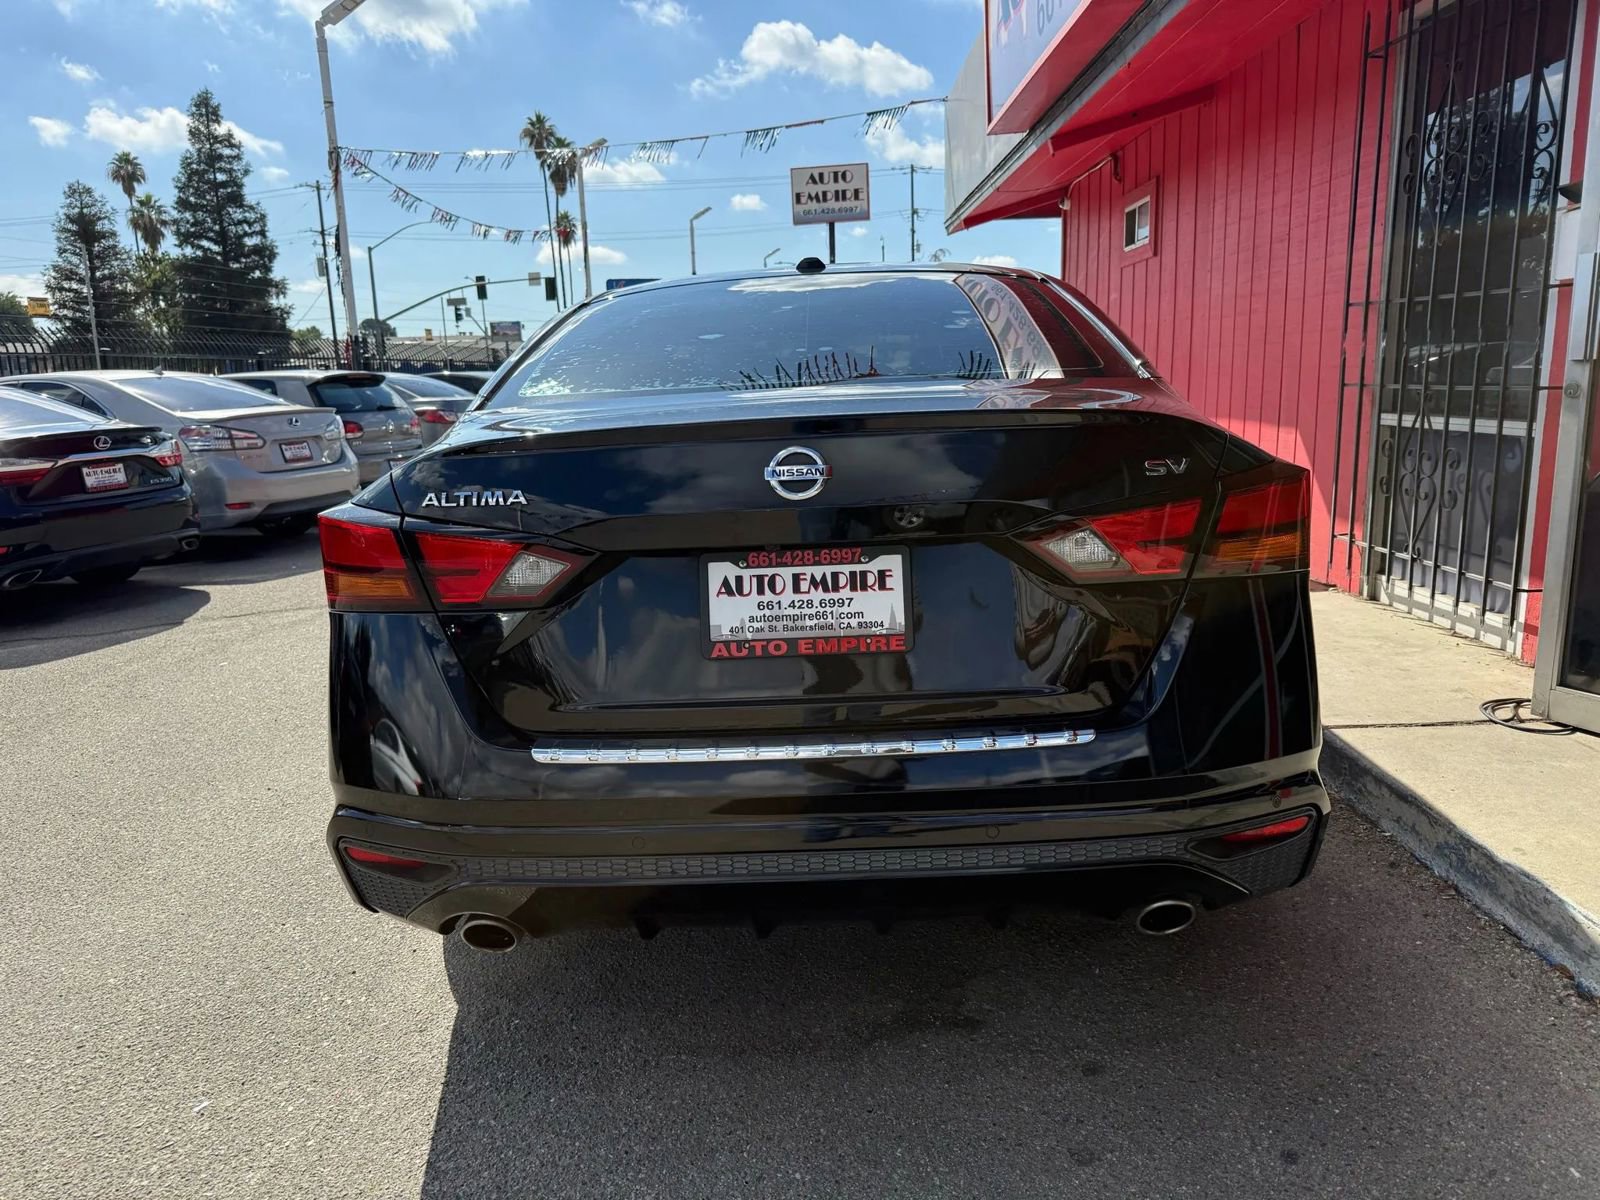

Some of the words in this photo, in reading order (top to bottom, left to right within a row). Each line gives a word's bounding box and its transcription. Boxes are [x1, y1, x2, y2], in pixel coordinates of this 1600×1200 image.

[805, 170, 853, 185] AUTO
[795, 188, 865, 206] EMPIRE
[802, 207, 858, 216] 661.428.6997
[772, 467, 825, 478] NISSAN
[1144, 457, 1190, 476] SV
[421, 489, 528, 507] ALTIMA
[747, 548, 862, 567] 661-428-6997
[716, 572, 786, 598] AUTO
[792, 569, 895, 595] EMPIRE
[757, 597, 855, 611] 661.428.6997
[748, 610, 865, 625] autoempire661.com
[729, 625, 745, 634] 401
[747, 623, 765, 634] Oak
[767, 623, 780, 633] St.
[782, 622, 836, 633] Bakersfield,
[838, 621, 855, 631] CA.
[857, 620, 885, 630] 93304
[711, 639, 789, 658] AUTO
[798, 635, 906, 655] EMPIRE
